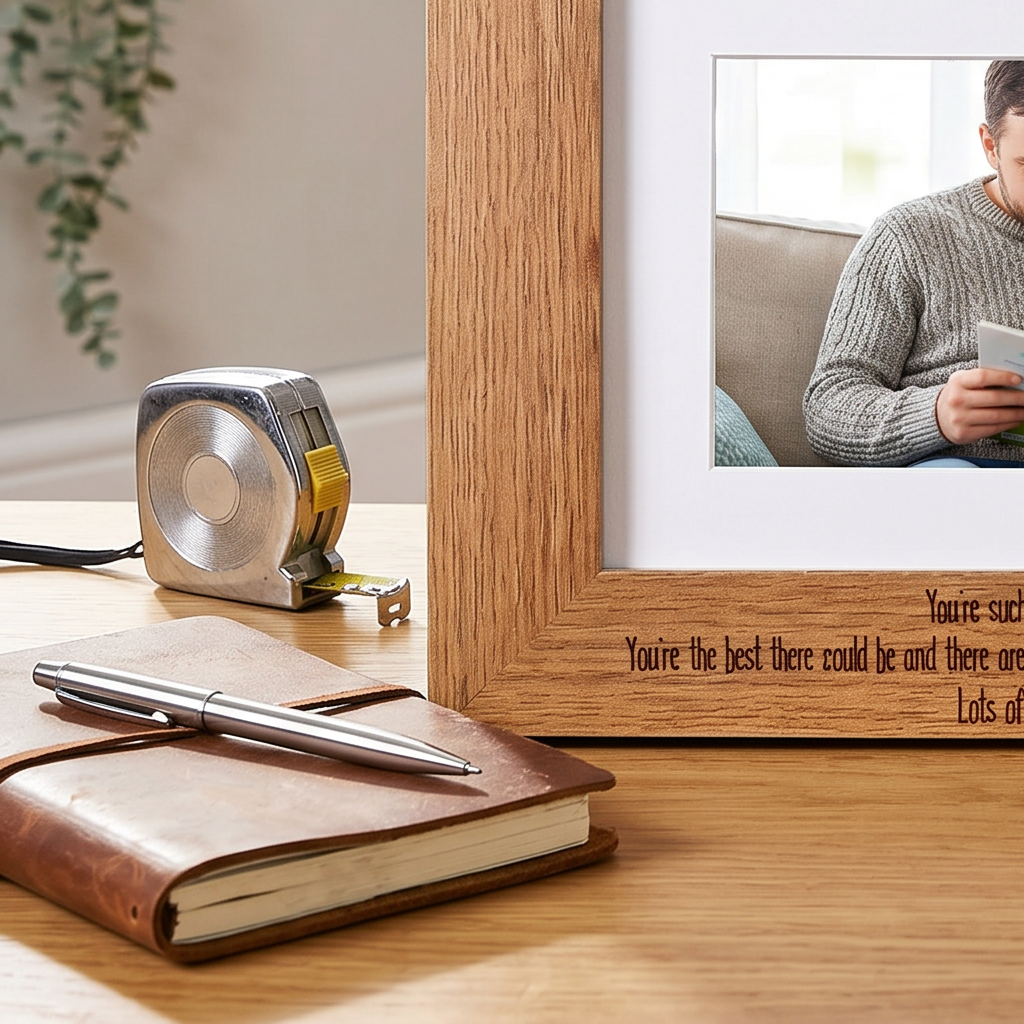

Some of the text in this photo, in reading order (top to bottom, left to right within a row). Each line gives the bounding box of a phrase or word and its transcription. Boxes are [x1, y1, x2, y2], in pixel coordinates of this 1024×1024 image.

[925, 588, 980, 624] You're
[625, 636, 680, 672] You're
[688, 636, 717, 671] the
[725, 635, 764, 674] best
[769, 636, 814, 672] there
[822, 635, 868, 672] could
[876, 636, 896, 674] be
[903, 636, 937, 671] and
[944, 636, 990, 672] there
[957, 686, 997, 725] Lots
